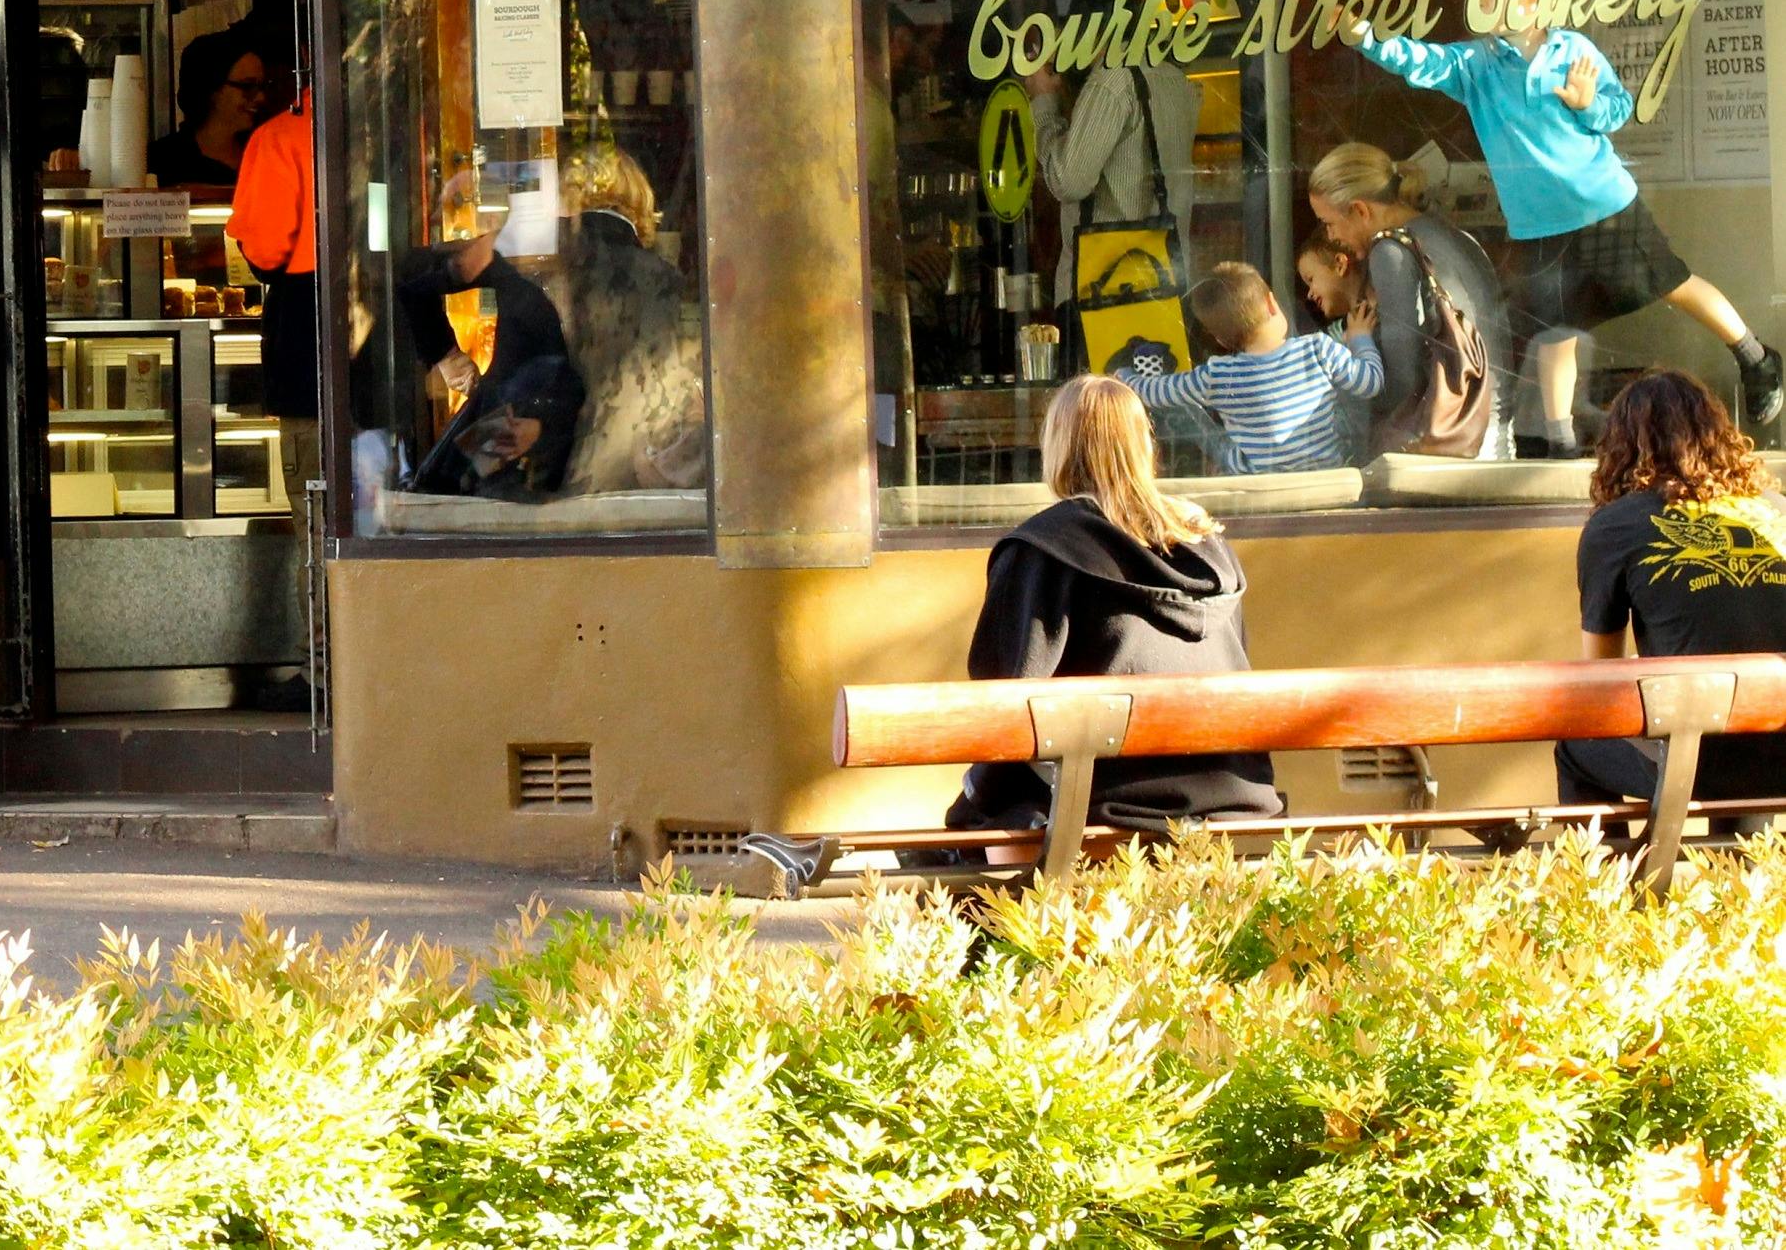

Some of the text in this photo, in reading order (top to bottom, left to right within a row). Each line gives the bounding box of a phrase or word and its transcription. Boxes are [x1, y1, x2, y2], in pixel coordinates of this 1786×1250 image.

[494, 5, 540, 14] SOURDOUGH
[1703, 5, 1763, 23] BAKERY
[1704, 34, 1764, 54] AFTER
[1705, 56, 1765, 76] HOURS
[1707, 104, 1766, 122] NOW OPEN
[107, 199, 131, 208] Please
[134, 199, 144, 207] do
[145, 199, 158, 207] not
[107, 212, 187, 222] place anything heavy
[118, 226, 131, 234] the
[133, 227, 152, 236] glass
[1728, 557, 1749, 573] 66
[1689, 573, 1720, 592] SOUTH
